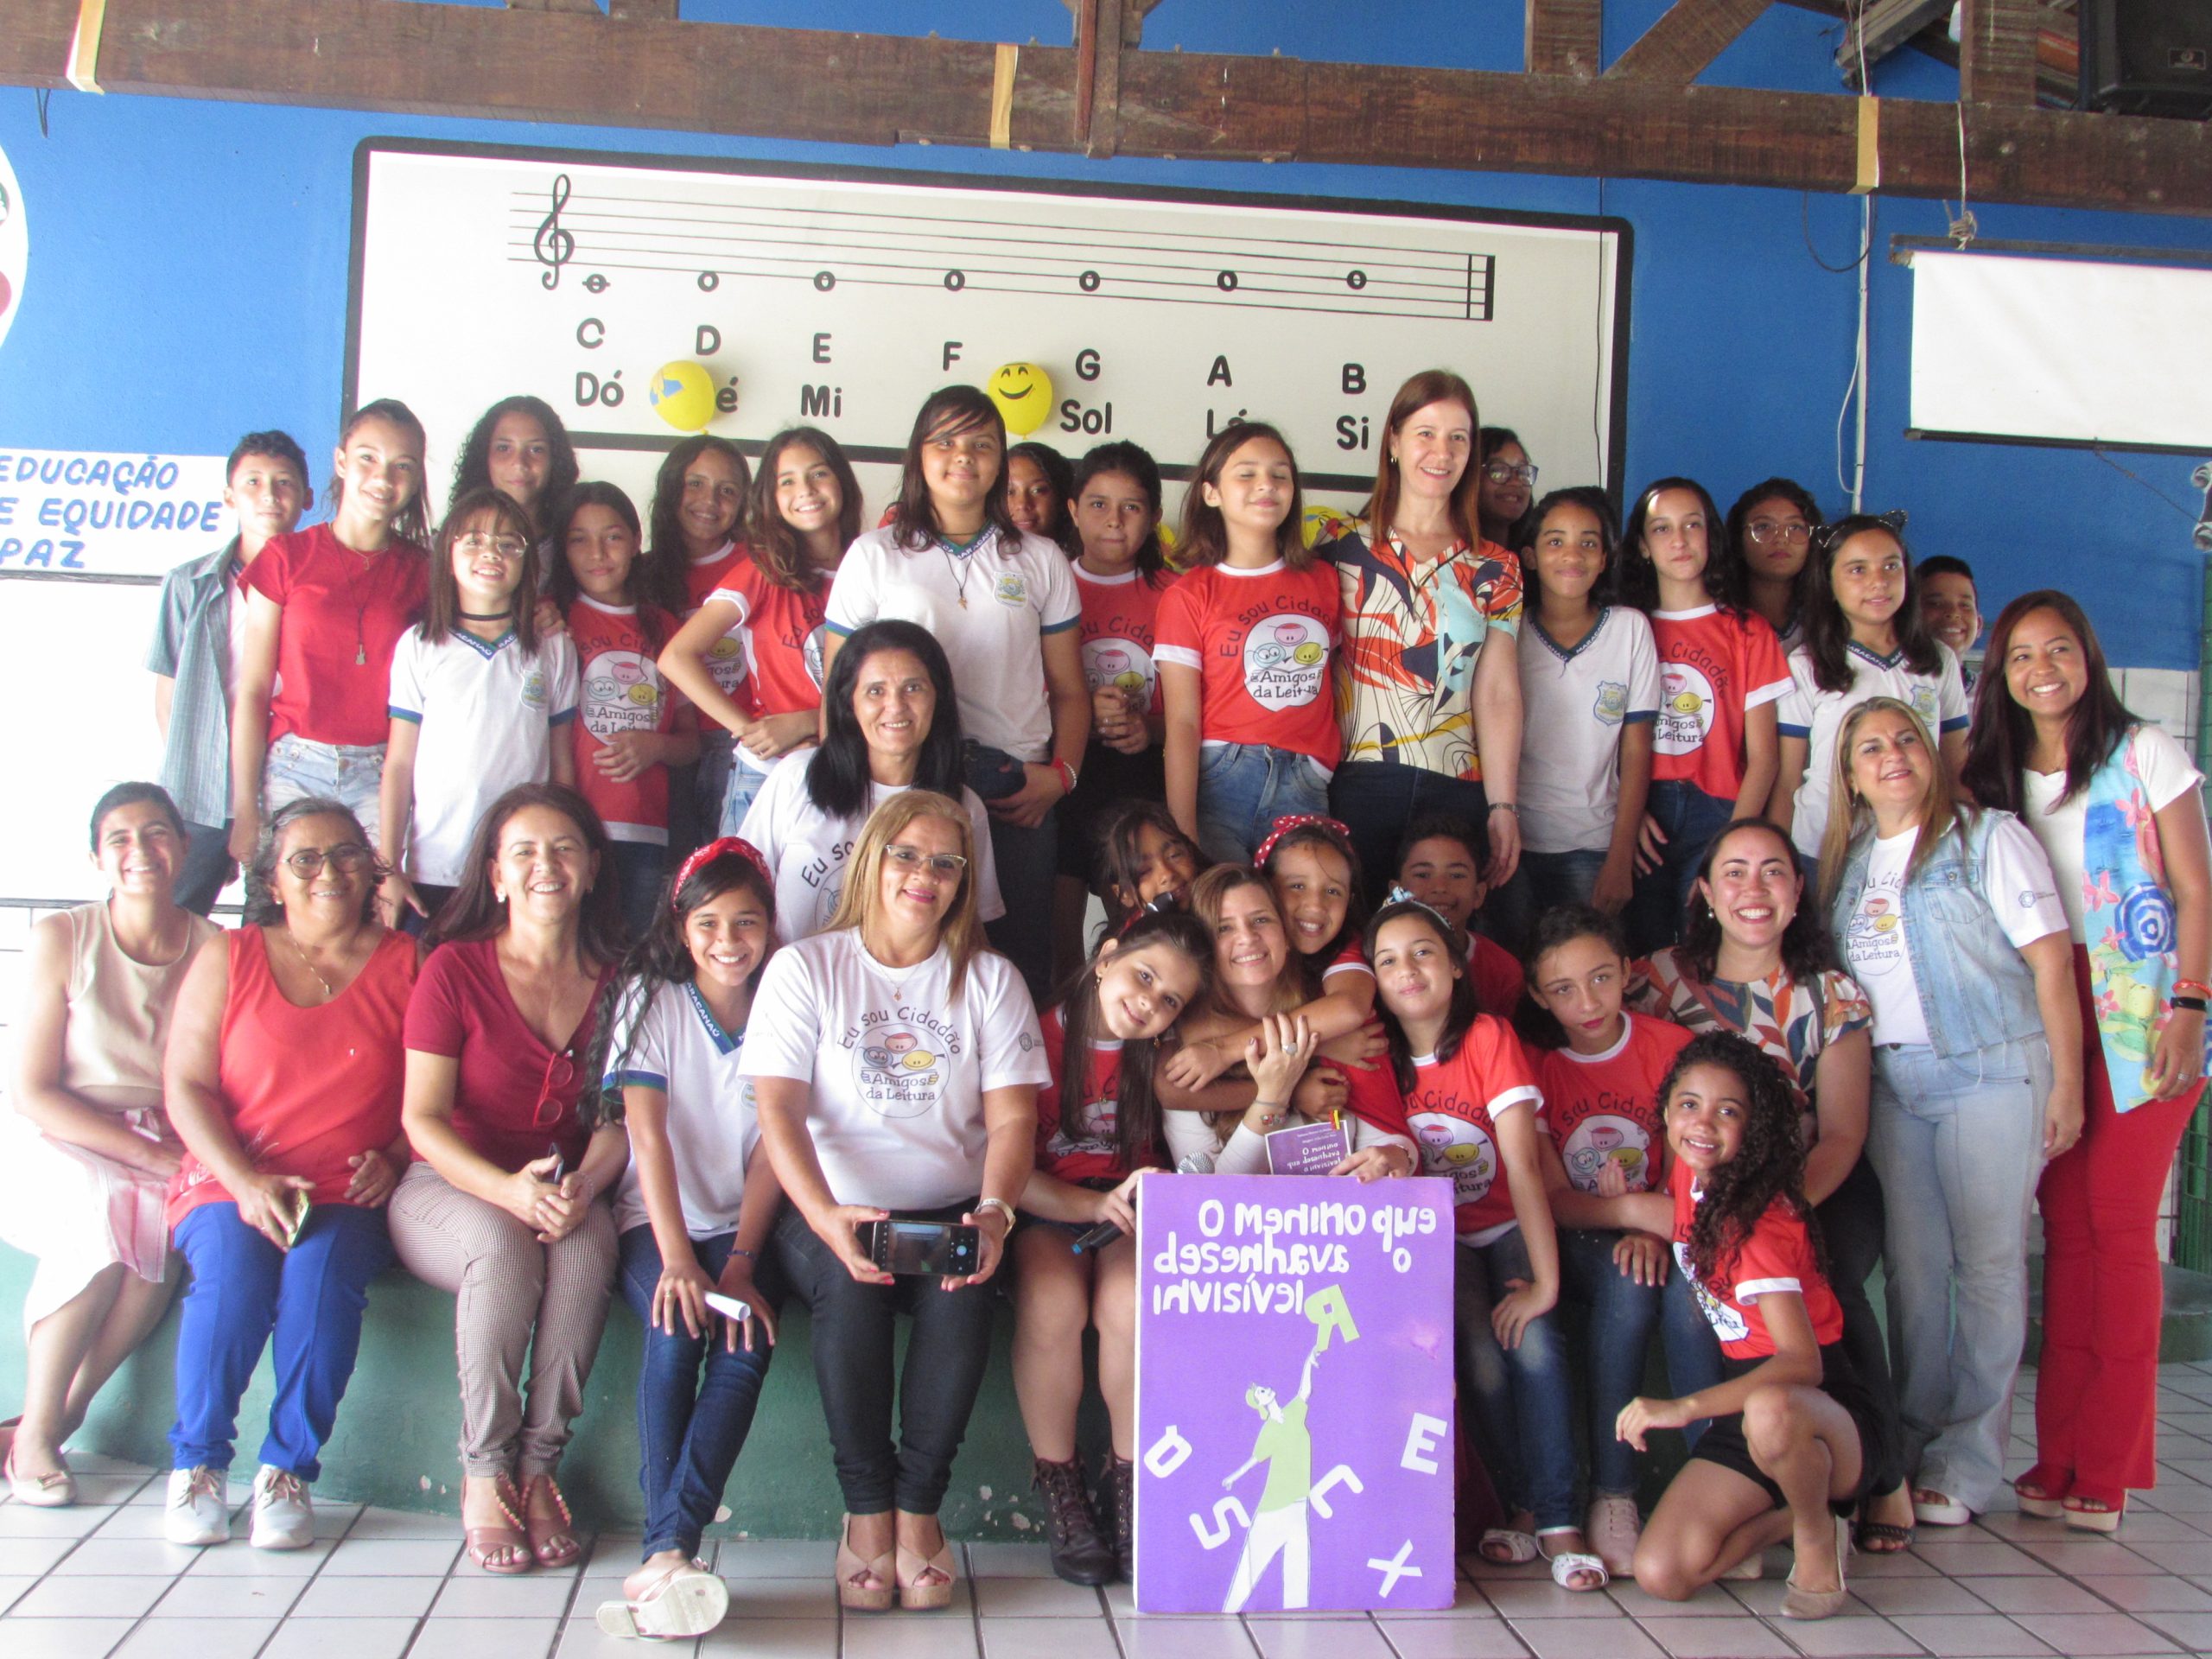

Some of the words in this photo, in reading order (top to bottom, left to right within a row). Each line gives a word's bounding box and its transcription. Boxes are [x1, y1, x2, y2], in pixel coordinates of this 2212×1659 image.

[575, 317, 606, 350] C
[695, 324, 721, 357] D
[812, 332, 832, 364] E
[942, 340, 963, 372] F
[1075, 348, 1101, 382] G
[1206, 354, 1233, 388] A
[1342, 363, 1367, 395] B
[575, 369, 625, 408] Dó
[715, 376, 739, 414] é
[800, 384, 842, 418] Mi
[1059, 398, 1112, 435] Sol
[1336, 415, 1370, 451] Si
[0, 455, 179, 495] EDUCAÇÃO
[38, 498, 223, 536] EQUIDADE
[0, 537, 85, 569] PAZ
[1220, 629, 1242, 658] Eu
[1237, 601, 1269, 626] sou
[1253, 685, 1272, 699] da
[1260, 671, 1316, 686] Amigos
[591, 721, 608, 734] da
[598, 706, 650, 724] Amigos
[1656, 717, 1695, 732] migos
[802, 857, 828, 888] Eu
[1852, 938, 1891, 953] Amigos
[1862, 949, 1900, 962] Leitura
[836, 1026, 861, 1050] Eu
[861, 1009, 889, 1027] sou
[897, 1006, 961, 1055] Cidadão
[866, 1087, 883, 1100] da
[886, 1088, 936, 1102] Leitura
[872, 1072, 928, 1091] Amigos
[1198, 1199, 1225, 1237] O
[1371, 1204, 1437, 1253] que
[1154, 1226, 1350, 1275] desenhava
[1392, 1247, 1412, 1274] o
[1400, 1412, 1448, 1475] E
[1367, 1539, 1423, 1599] X
